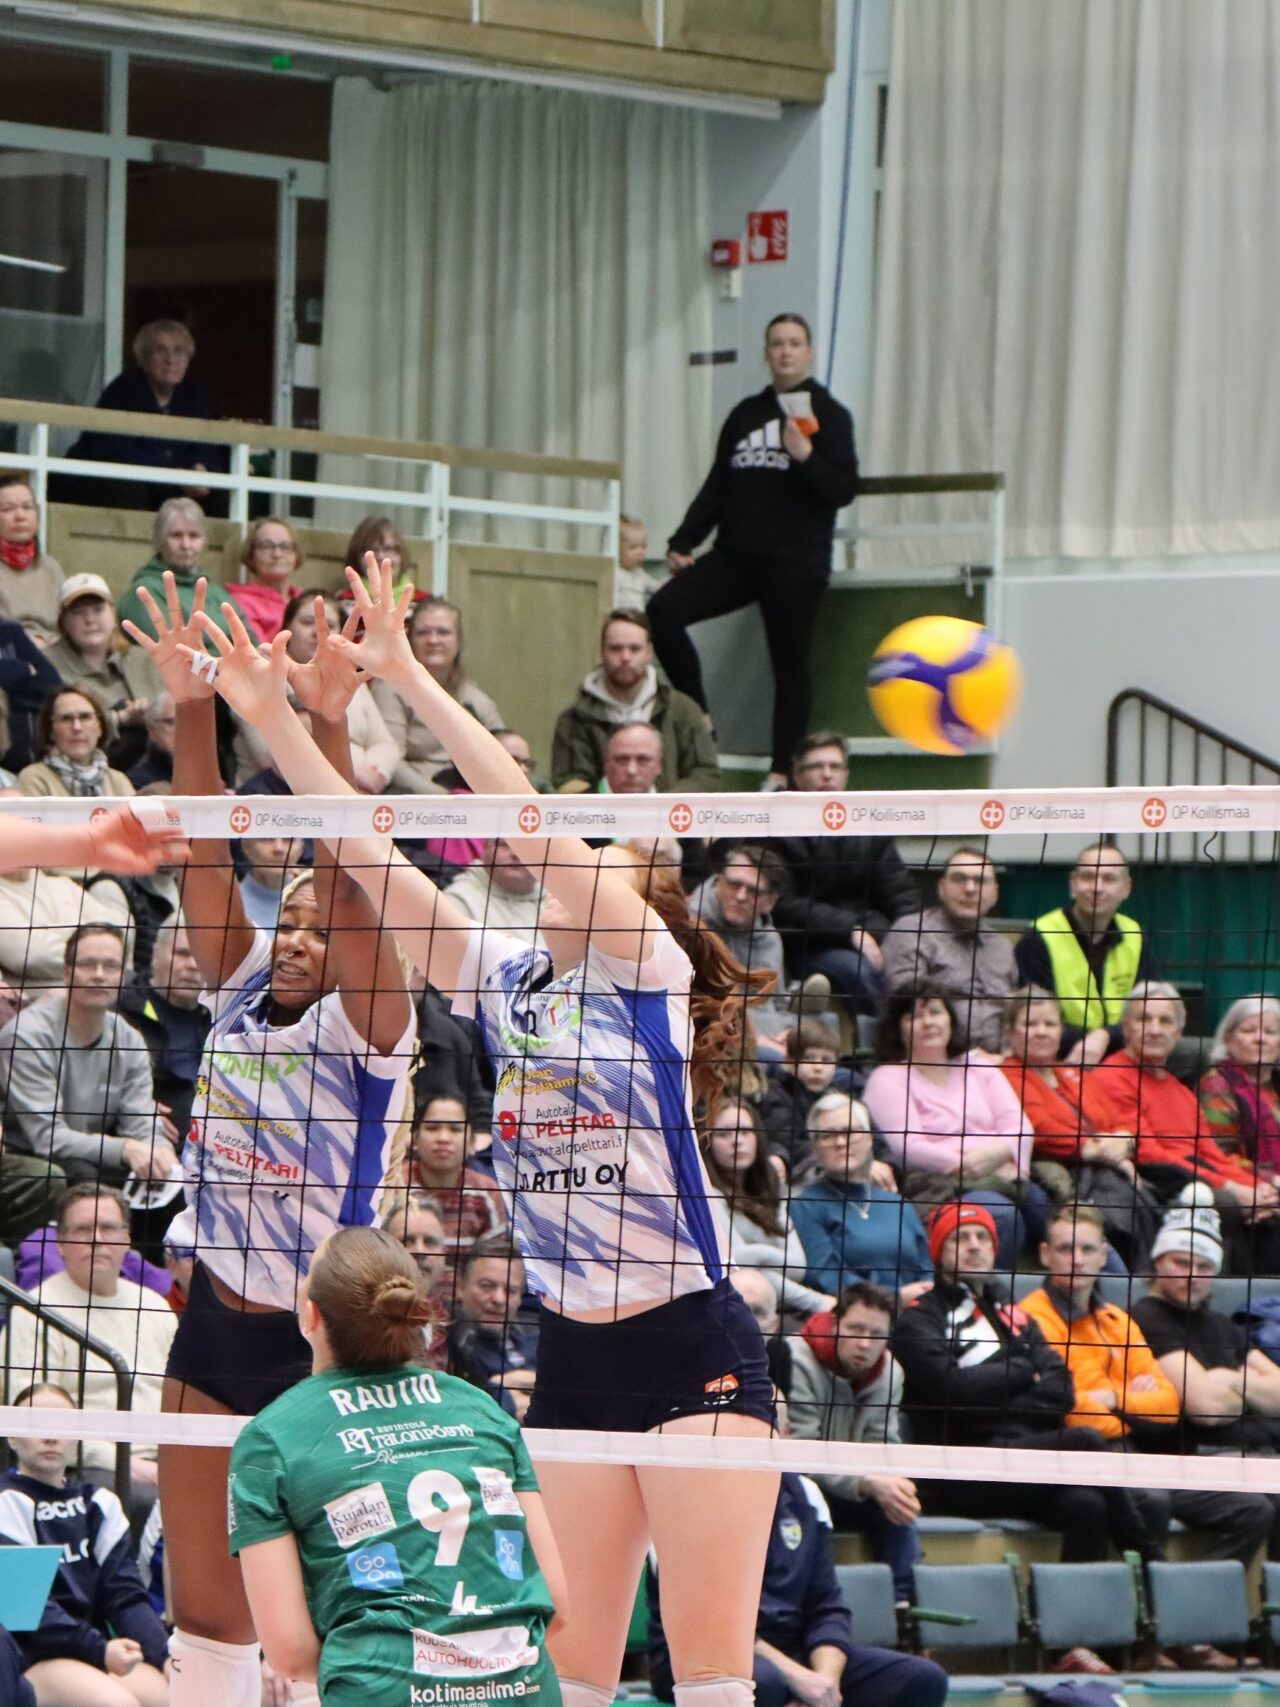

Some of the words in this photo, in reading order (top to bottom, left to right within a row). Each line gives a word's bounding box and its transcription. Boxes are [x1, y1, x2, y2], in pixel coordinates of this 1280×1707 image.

[398, 812, 414, 826] OP
[415, 812, 467, 826] Koillismaa
[545, 811, 561, 825] OP
[562, 810, 616, 825] Koillismaa
[697, 811, 713, 825] OP
[715, 810, 770, 825] Koillismaa
[851, 808, 867, 822] OP
[869, 807, 926, 821] Koillismaa
[1009, 807, 1026, 820] OP
[1027, 806, 1086, 820] Koillismaa
[1172, 805, 1189, 820] OP
[1190, 805, 1250, 820] Koillismaa
[255, 813, 269, 828] OP
[271, 814, 323, 828] Koillismaa
[214, 1143, 298, 1179] PELTTARI
[595, 1161, 629, 1183] OY
[331, 1498, 387, 1526] Kujalan
[407, 1469, 471, 1566] 9
[336, 1511, 392, 1540] Porotila
[355, 1554, 386, 1573] Go
[366, 1569, 398, 1582] On
